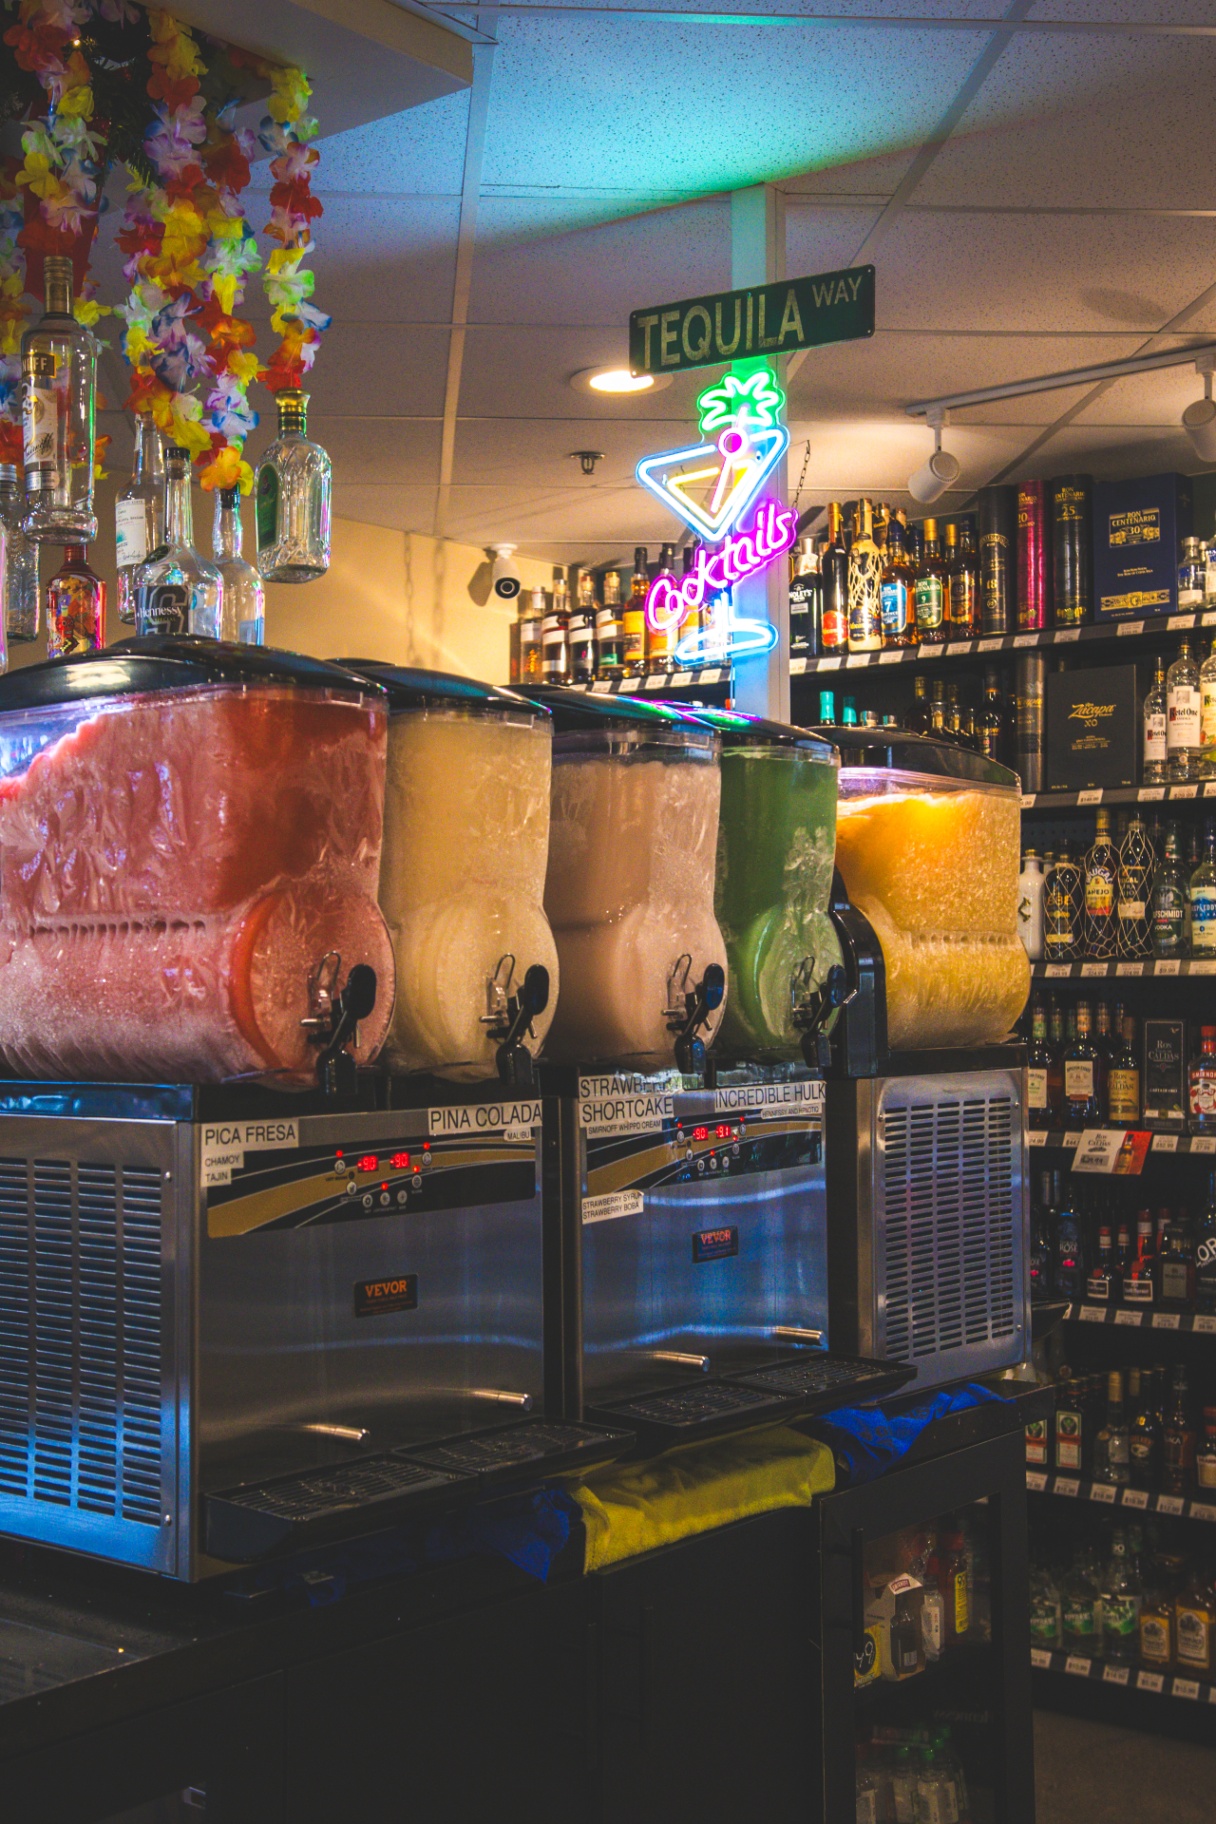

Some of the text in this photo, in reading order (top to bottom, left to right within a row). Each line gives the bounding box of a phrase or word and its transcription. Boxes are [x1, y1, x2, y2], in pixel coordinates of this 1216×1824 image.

[637, 275, 862, 369] TEQUILA WAY
[1062, 504, 1076, 516] 25
[1111, 514, 1156, 527] CENTENARIO
[648, 501, 794, 632] Cocktails
[139, 606, 183, 618] Hennessy
[884, 601, 892, 613] 7
[1068, 703, 1117, 719] Zacapa
[715, 1083, 826, 1108] INCREDIBLE HULK
[431, 1103, 542, 1130] PINA COLADA
[582, 1096, 673, 1122] SHORTCAKE
[205, 1124, 296, 1146] PICA FRESA
[507, 1130, 530, 1139] MALIBU
[588, 1124, 618, 1134] SMIRNOFF
[641, 1120, 660, 1128] CREAM
[205, 1155, 240, 1167] CHAMOY
[205, 1171, 228, 1182] TAJIN
[583, 1196, 622, 1210] STRAWBERRY
[583, 1201, 639, 1219] STRAWBERRY BOBA
[700, 1229, 731, 1245] VEVOR
[365, 1279, 407, 1298] VEVOR
